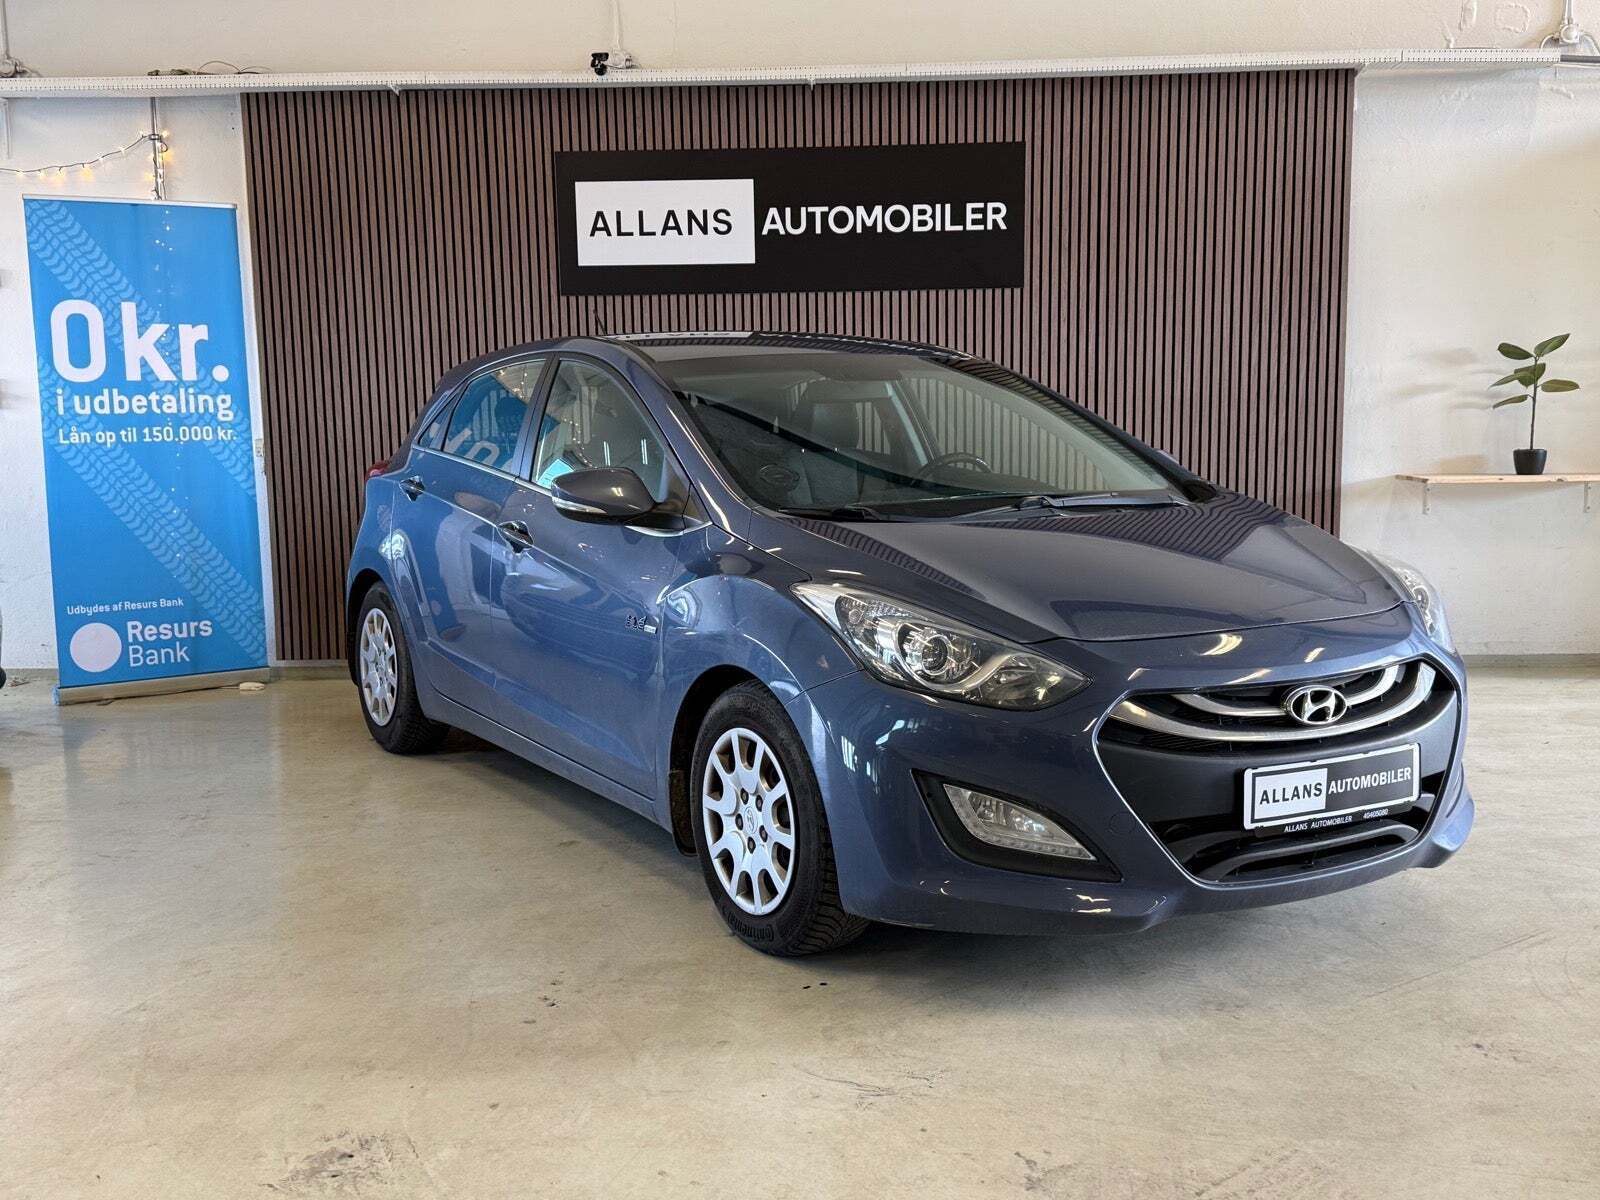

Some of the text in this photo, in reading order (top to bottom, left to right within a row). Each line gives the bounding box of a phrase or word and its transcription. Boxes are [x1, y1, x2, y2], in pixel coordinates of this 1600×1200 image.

[589, 201, 1008, 238] ALLANS AUTOMOBILER
[50, 299, 230, 383] 0 kr.
[55, 388, 234, 422] i udbetaling
[58, 425, 237, 447] Lån op til 150.000 kr.
[66, 597, 185, 617] Udbydes af Resurs Bank
[126, 619, 213, 643] Resurs
[128, 641, 190, 668] Bank
[1259, 767, 1412, 805] ALLANS AUTOMOBILER
[1283, 822, 1308, 833] ALLANS
[1310, 815, 1353, 830] AUTOMOBILER
